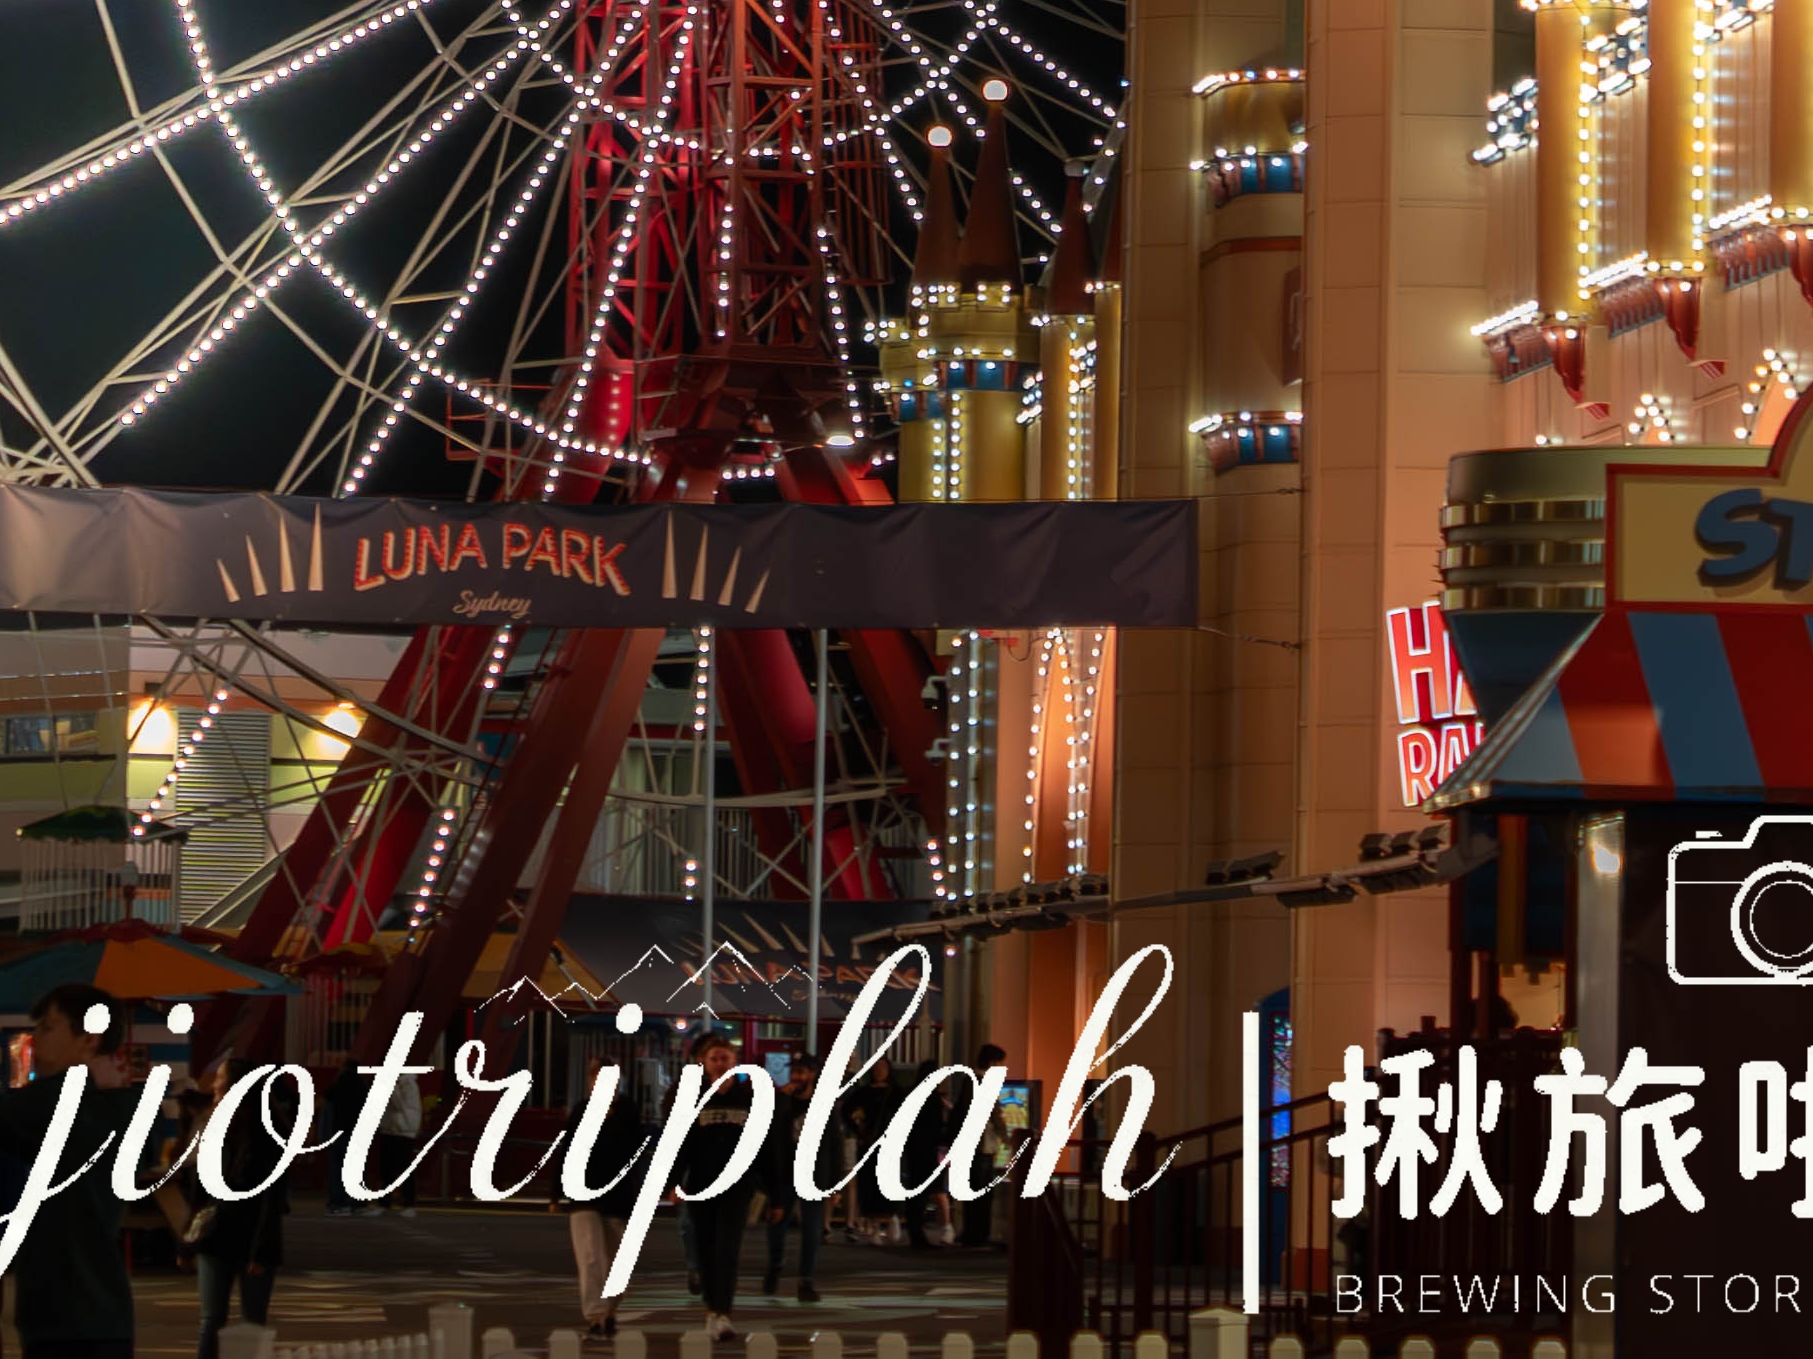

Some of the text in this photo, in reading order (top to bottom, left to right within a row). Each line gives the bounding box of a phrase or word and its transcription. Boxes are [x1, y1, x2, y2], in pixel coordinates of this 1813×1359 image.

[354, 523, 630, 596] LUNA PARK
[452, 589, 532, 619] Sydney
[1397, 715, 1485, 807] RA
